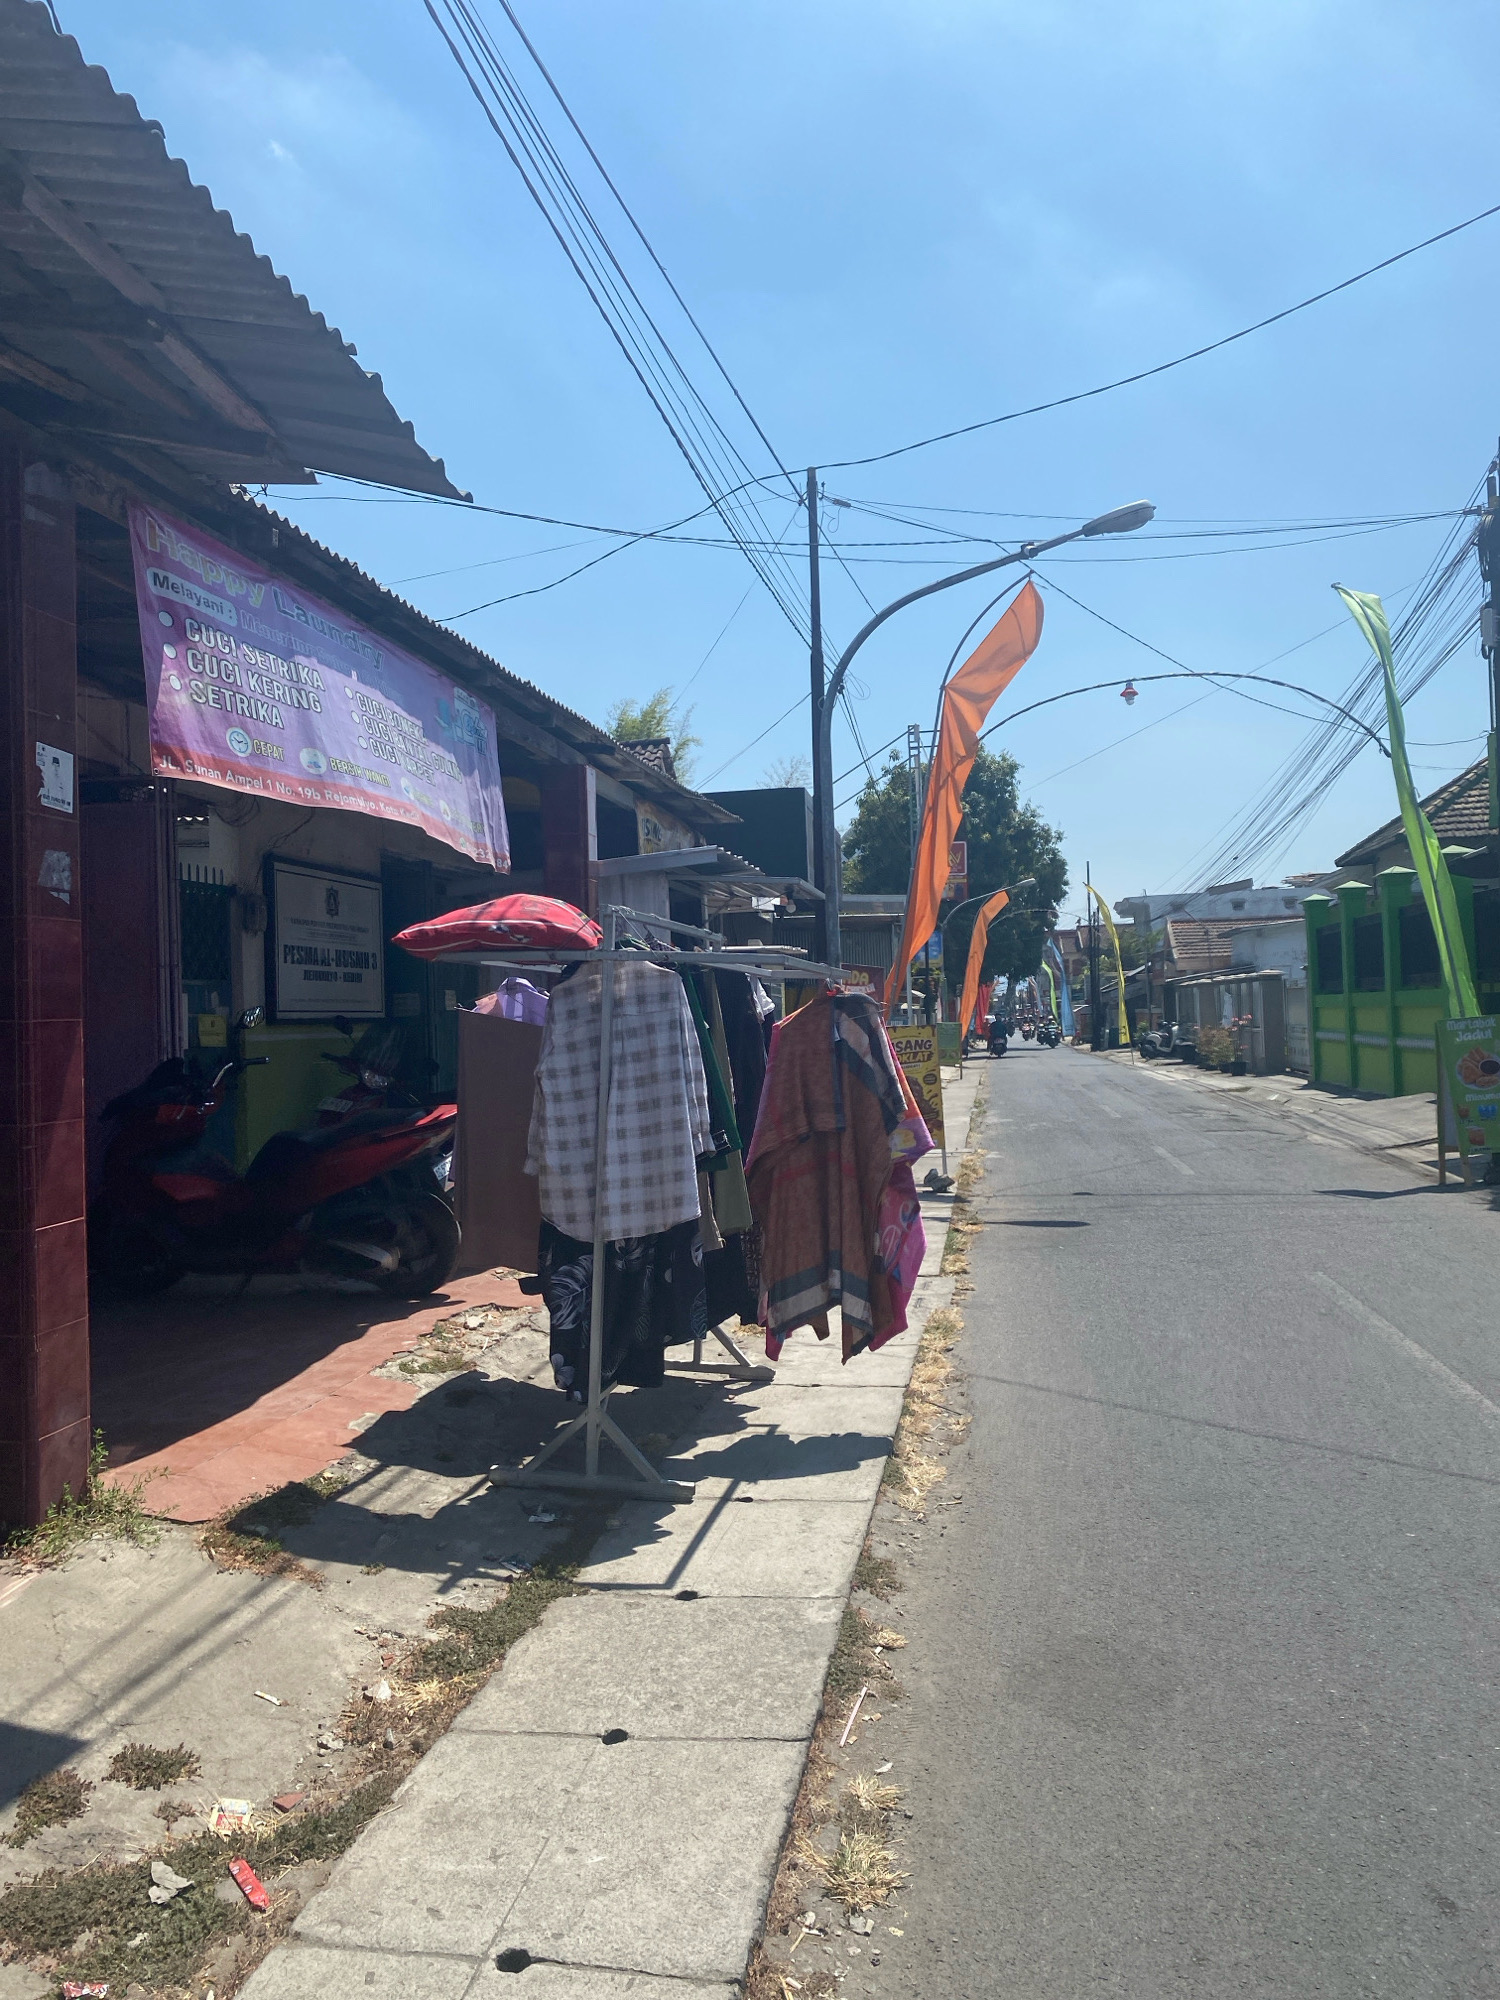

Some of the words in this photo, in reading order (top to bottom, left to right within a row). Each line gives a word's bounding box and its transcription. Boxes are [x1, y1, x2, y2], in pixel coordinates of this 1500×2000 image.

[146, 516, 265, 609] Happy
[272, 587, 385, 671] Laundry
[153, 571, 224, 614] Melayani
[184, 617, 238, 658] CUCI
[241, 642, 326, 691] SETRIKA
[186, 648, 243, 687] CUCI
[247, 669, 322, 713] KERING
[189, 679, 285, 730] SETRIKA
[355, 691, 388, 722] CUCI
[361, 713, 395, 744] CUCI
[253, 739, 284, 761] CEPAT
[368, 737, 401, 766] CUCI
[186, 760, 222, 781] Sunan
[225, 769, 263, 789] Ampel
[276, 782, 296, 796] No.
[892, 1039, 933, 1053] SANG
